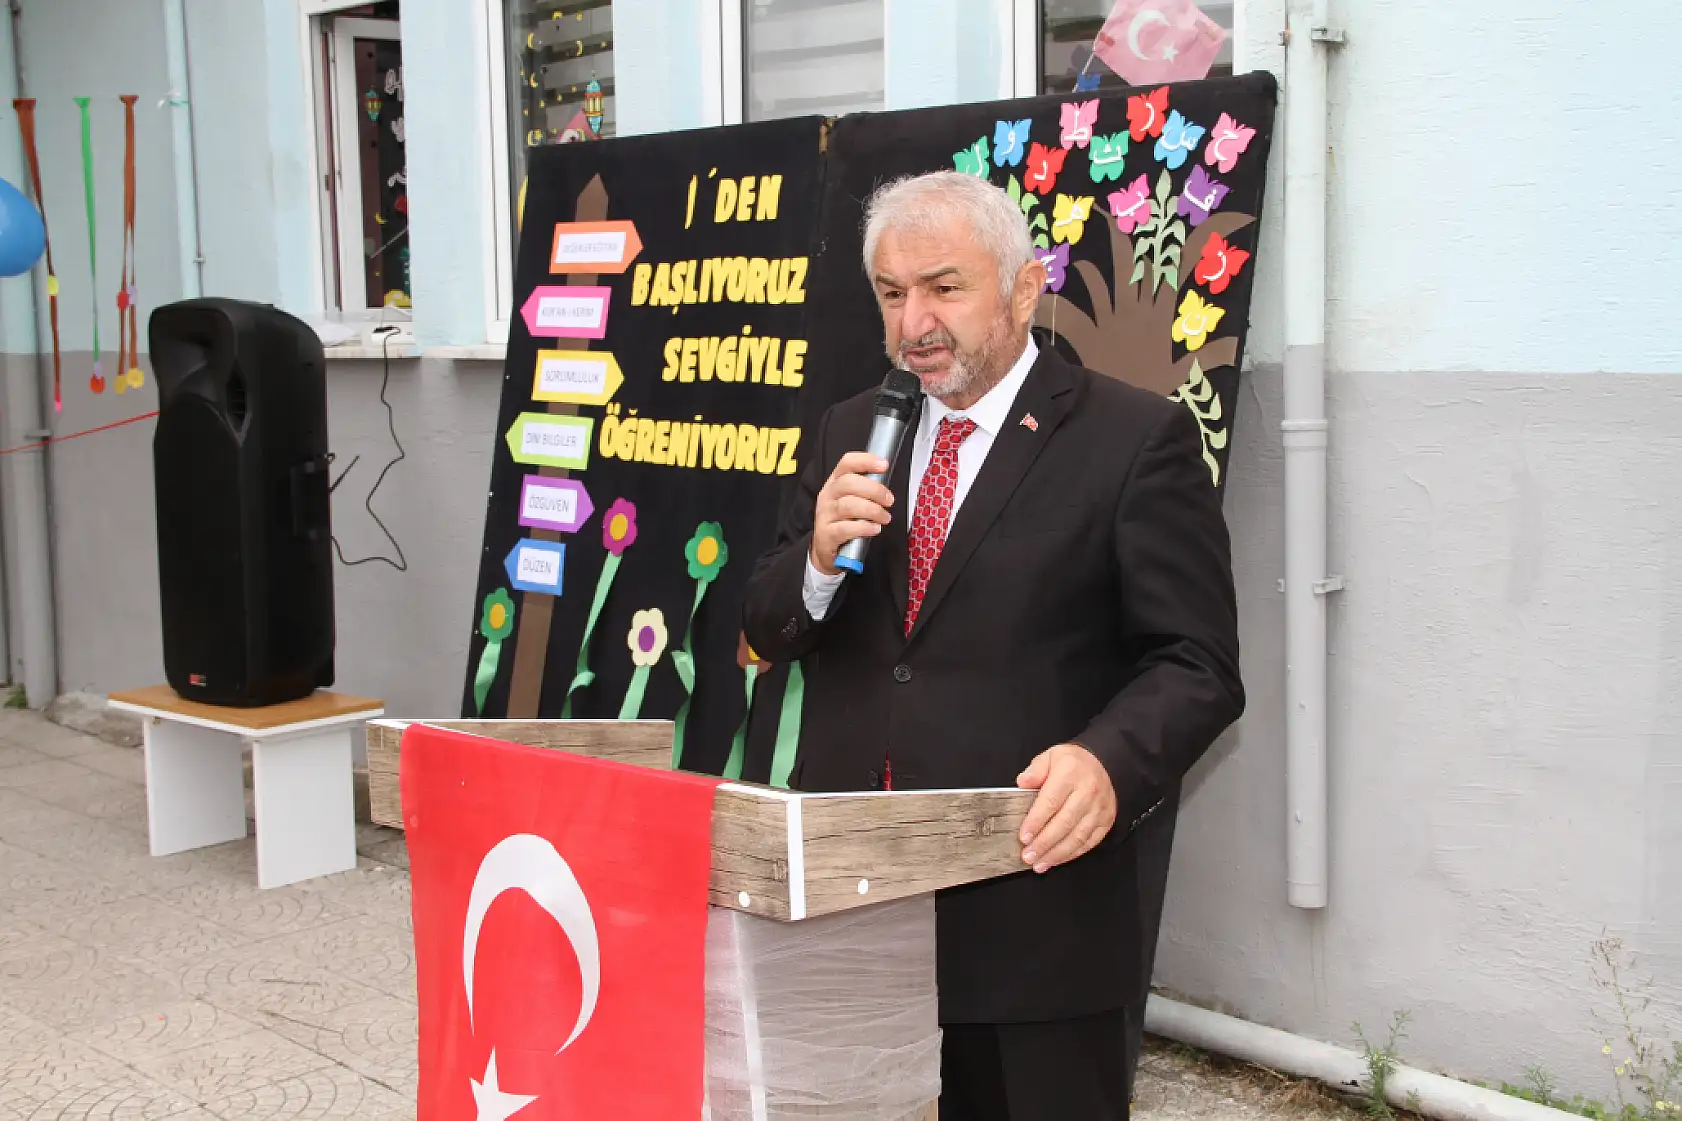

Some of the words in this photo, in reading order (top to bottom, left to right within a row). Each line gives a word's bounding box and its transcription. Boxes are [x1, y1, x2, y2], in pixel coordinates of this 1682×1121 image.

[1001, 130, 1016, 156] و
[1063, 109, 1089, 141] ط
[630, 257, 809, 315] BAŞLIYORUZ
[1182, 310, 1208, 336] ن
[661, 325, 809, 388] SEVGİYLE
[599, 403, 802, 476] ÖĞRENİYORUZ
